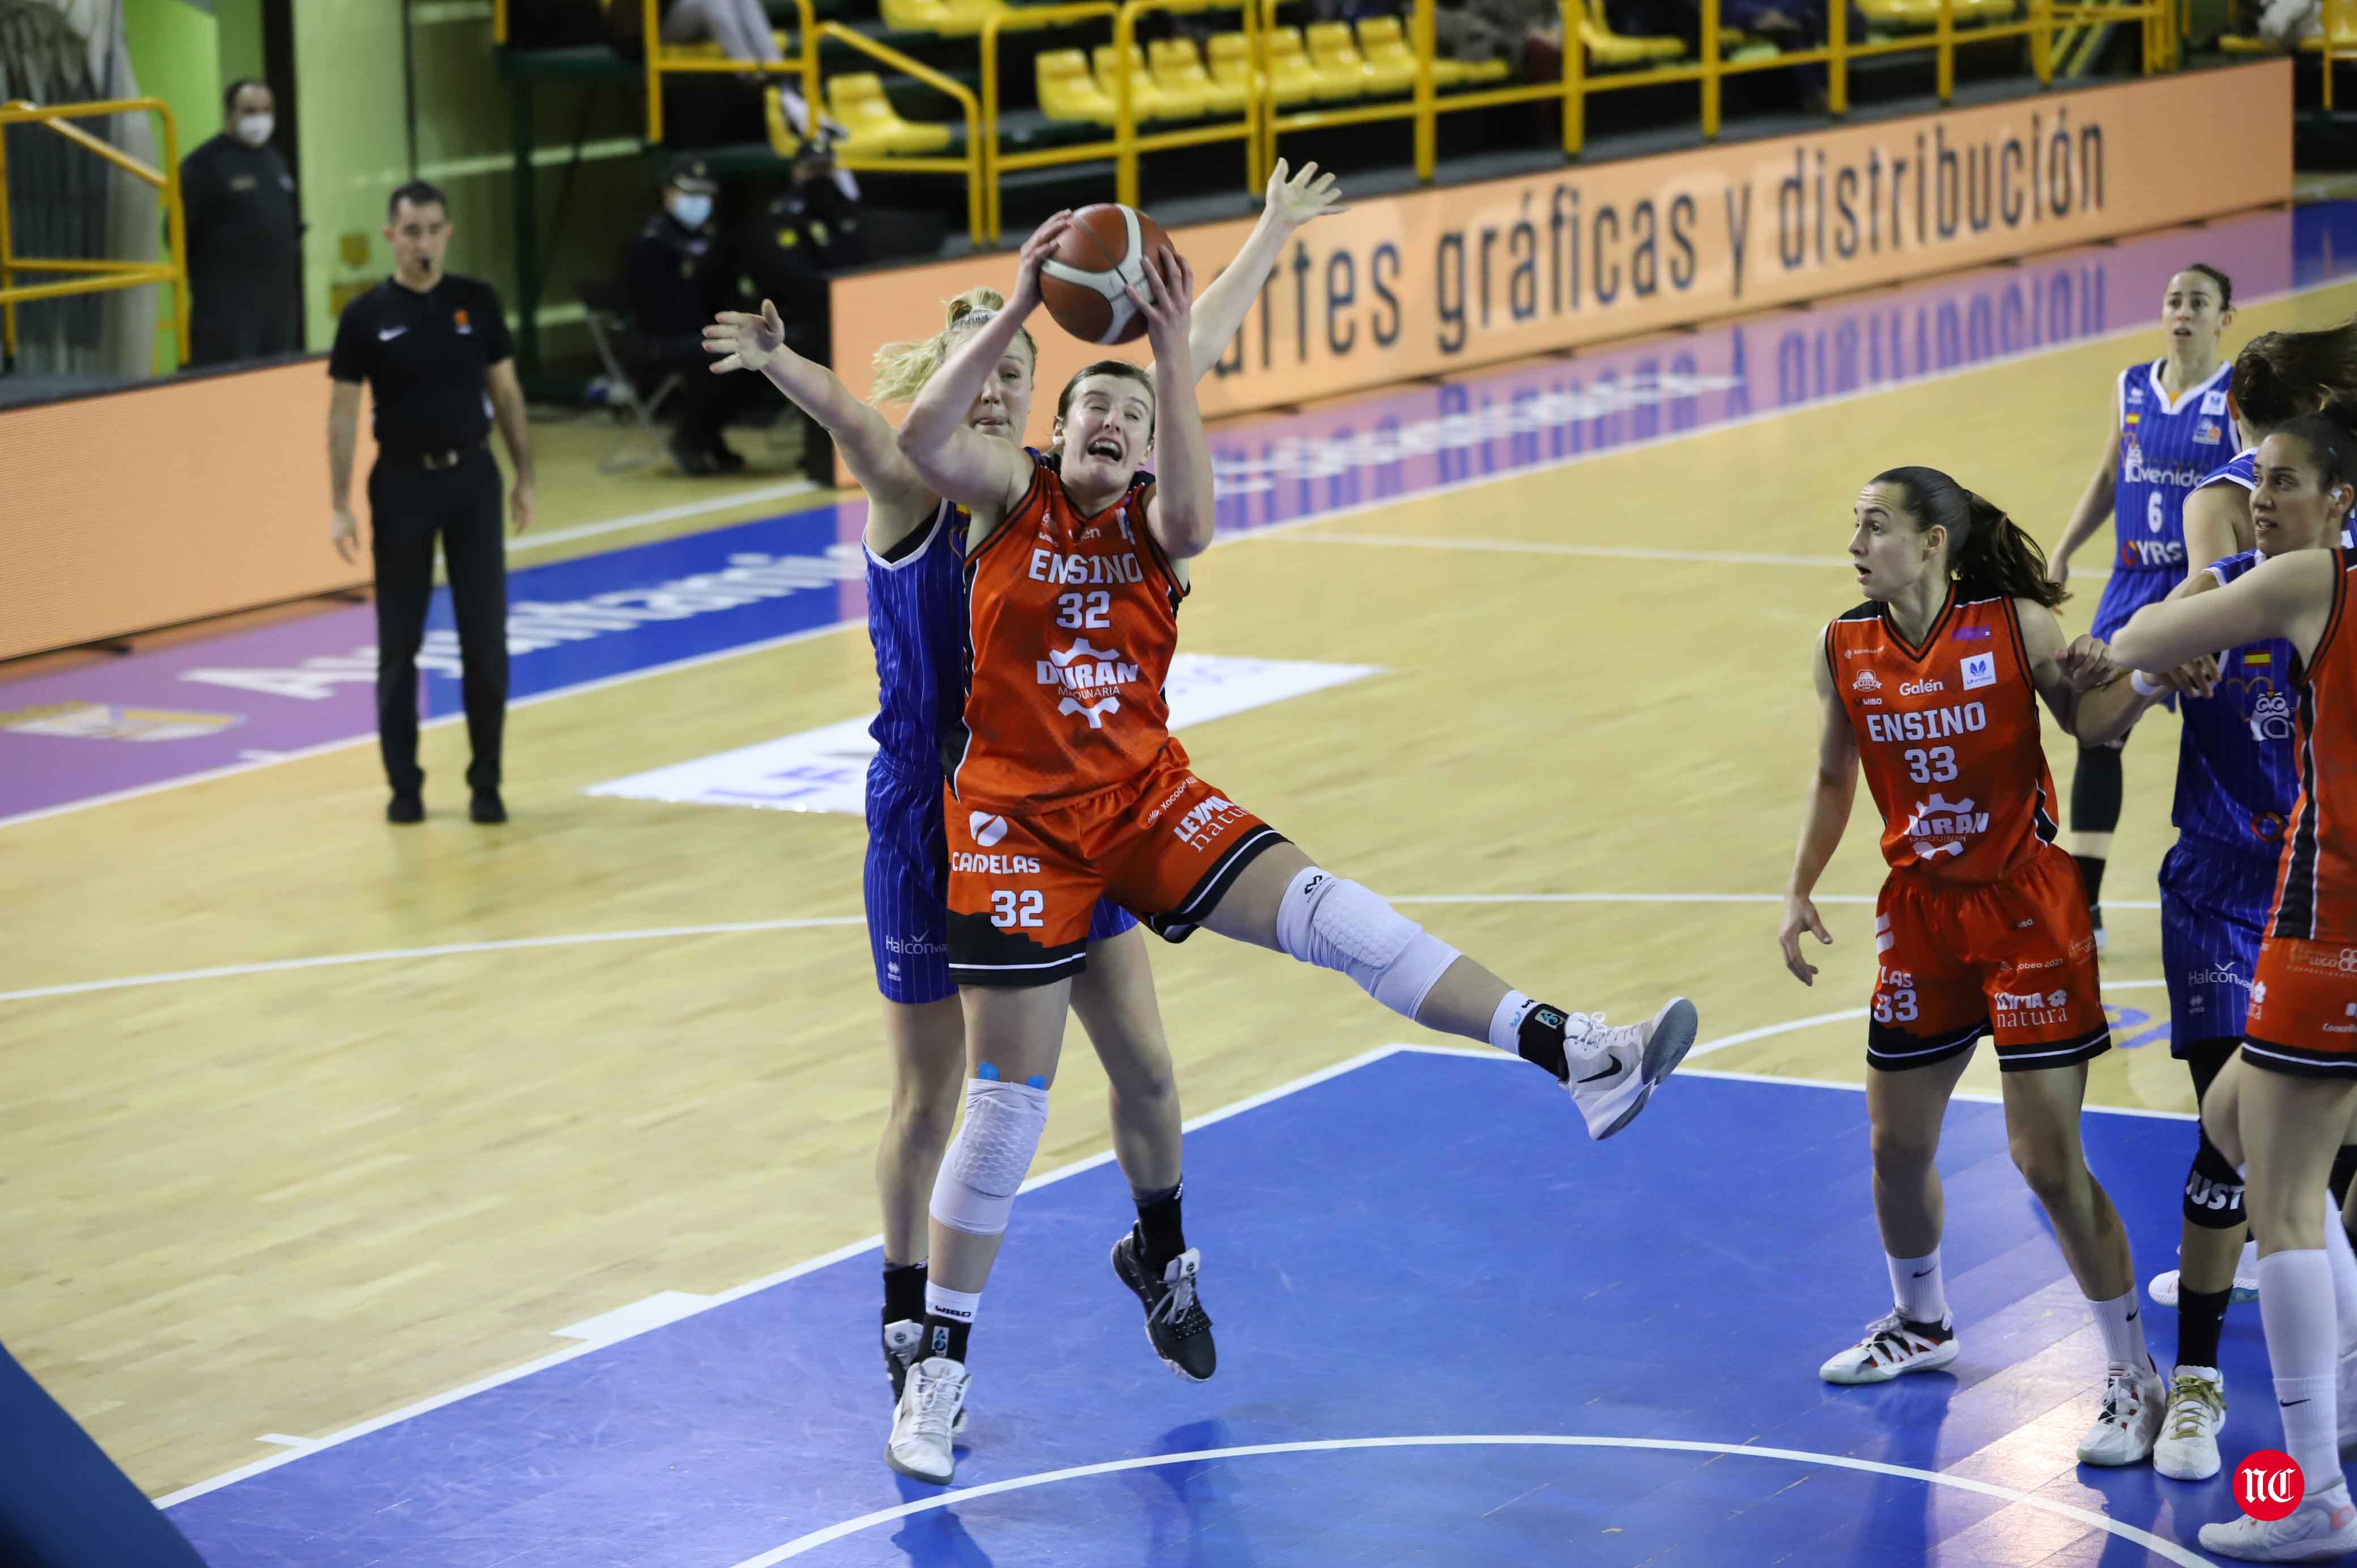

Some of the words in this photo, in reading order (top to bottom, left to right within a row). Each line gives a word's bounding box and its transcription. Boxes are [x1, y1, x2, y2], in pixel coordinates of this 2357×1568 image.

[1435, 184, 1696, 356] gráficas
[1725, 181, 1752, 299] y
[1778, 106, 2105, 270] distribución
[2147, 491, 2163, 534] 6
[1028, 548, 1143, 585] ENSINO
[1056, 590, 1111, 629] 32
[1036, 660, 1138, 691] DURAN
[1899, 679, 1944, 696] Galén
[1866, 701, 1986, 742] ENSINO
[1904, 745, 1958, 784] 33
[1189, 808, 1250, 853] natu
[990, 889, 1044, 928] 32
[1873, 988, 1919, 1023] 33
[1996, 1007, 2068, 1028] natura
